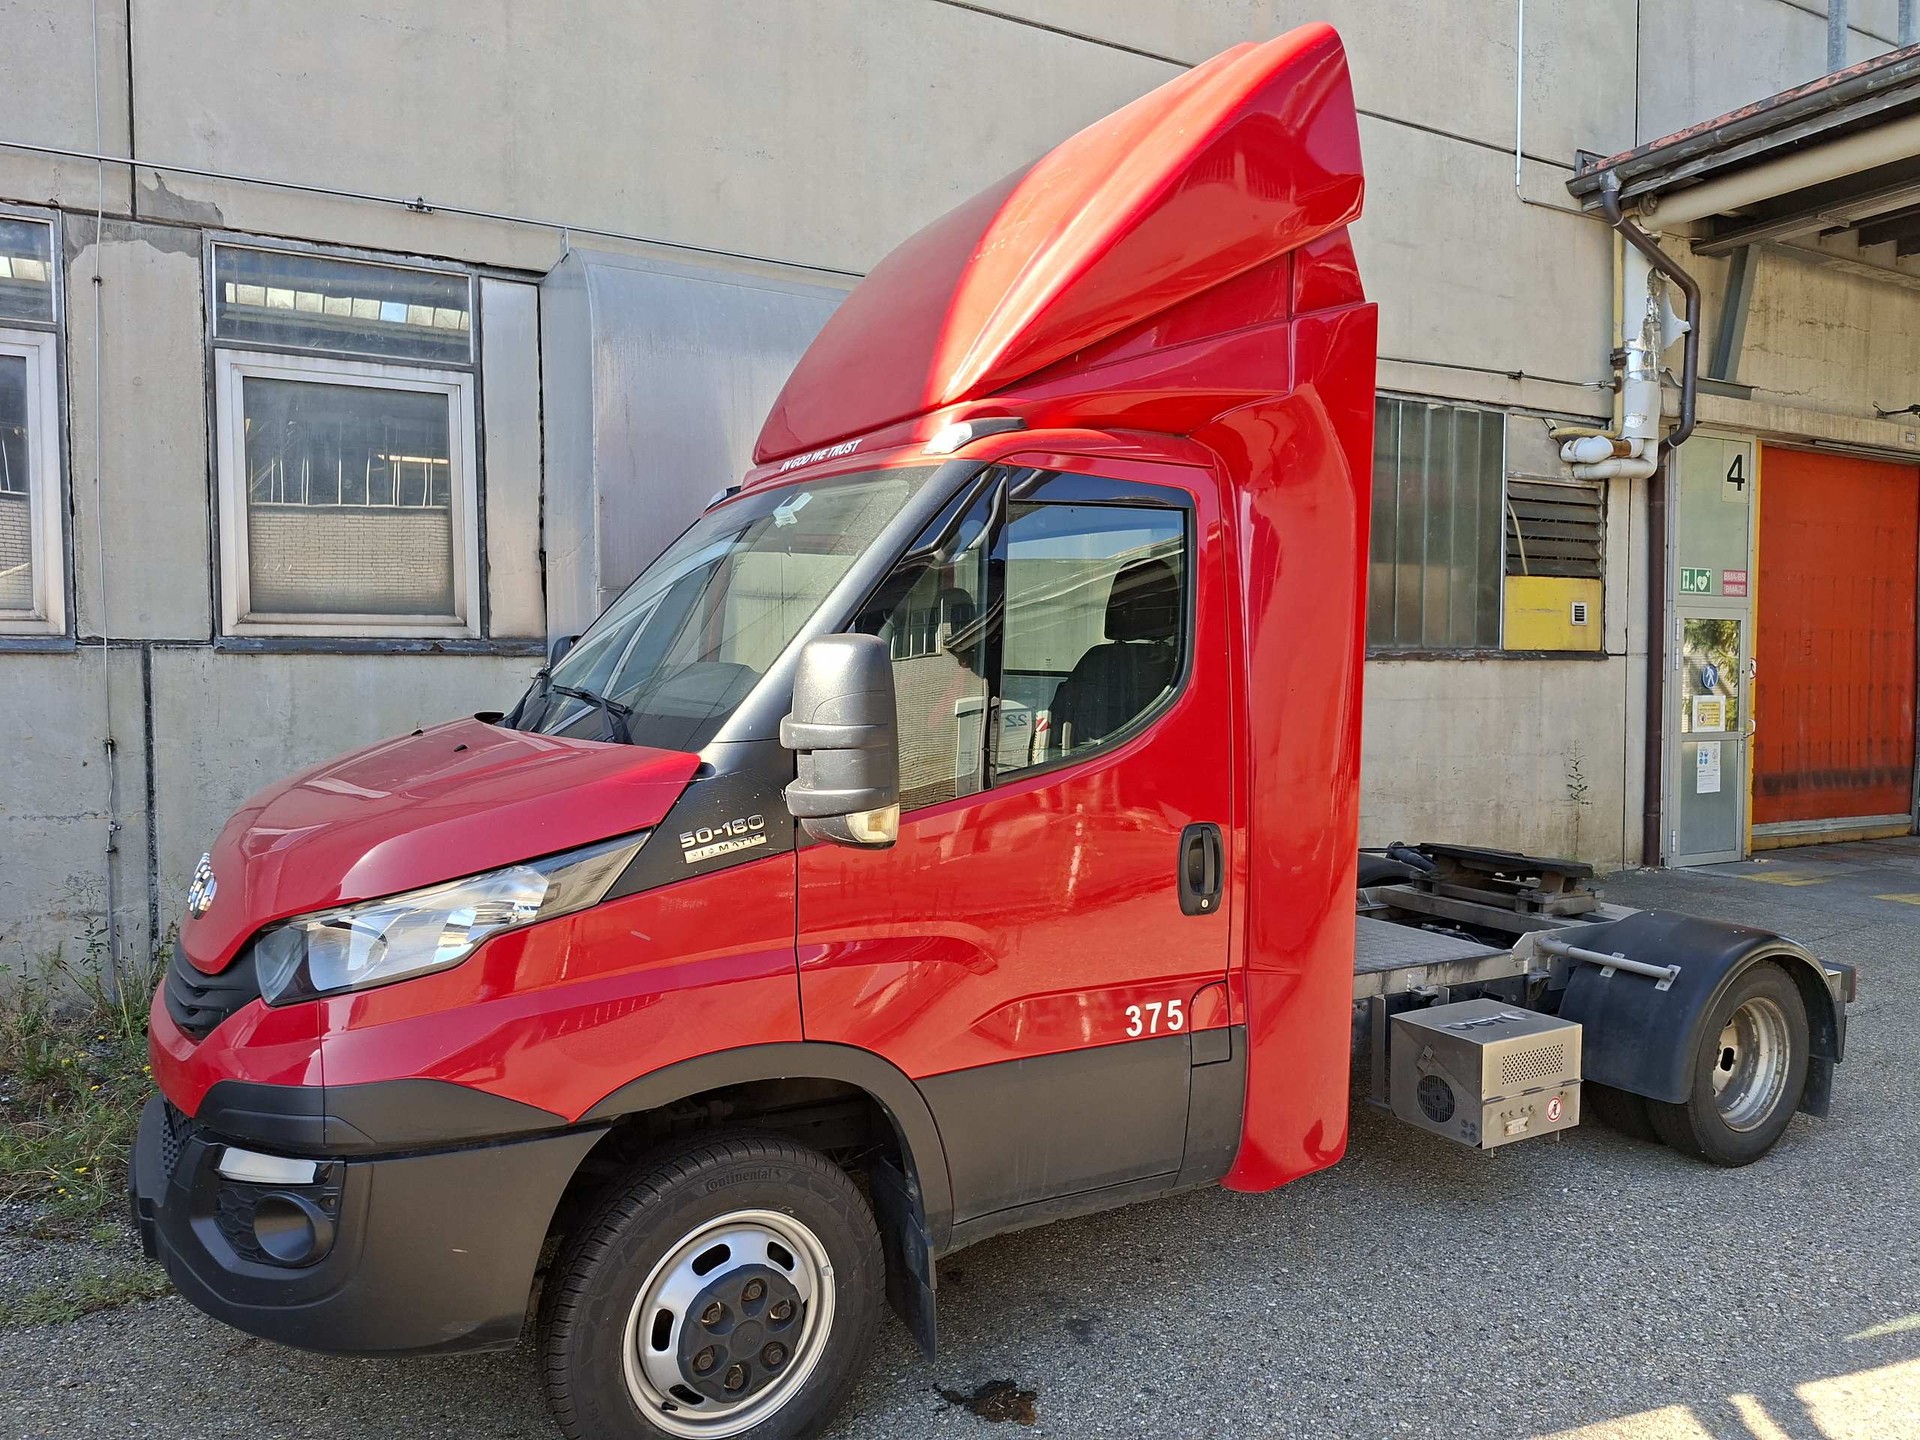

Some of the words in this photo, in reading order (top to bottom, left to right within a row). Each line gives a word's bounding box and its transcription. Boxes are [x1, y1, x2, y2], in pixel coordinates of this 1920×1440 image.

[780, 459, 793, 472] IN
[791, 454, 812, 468] GOD
[811, 449, 830, 462] WE
[827, 439, 863, 458] TRUST
[1727, 454, 1745, 491] 4
[680, 814, 765, 849] 50-180
[1125, 999, 1184, 1037] 375
[705, 1167, 772, 1193] Continental
